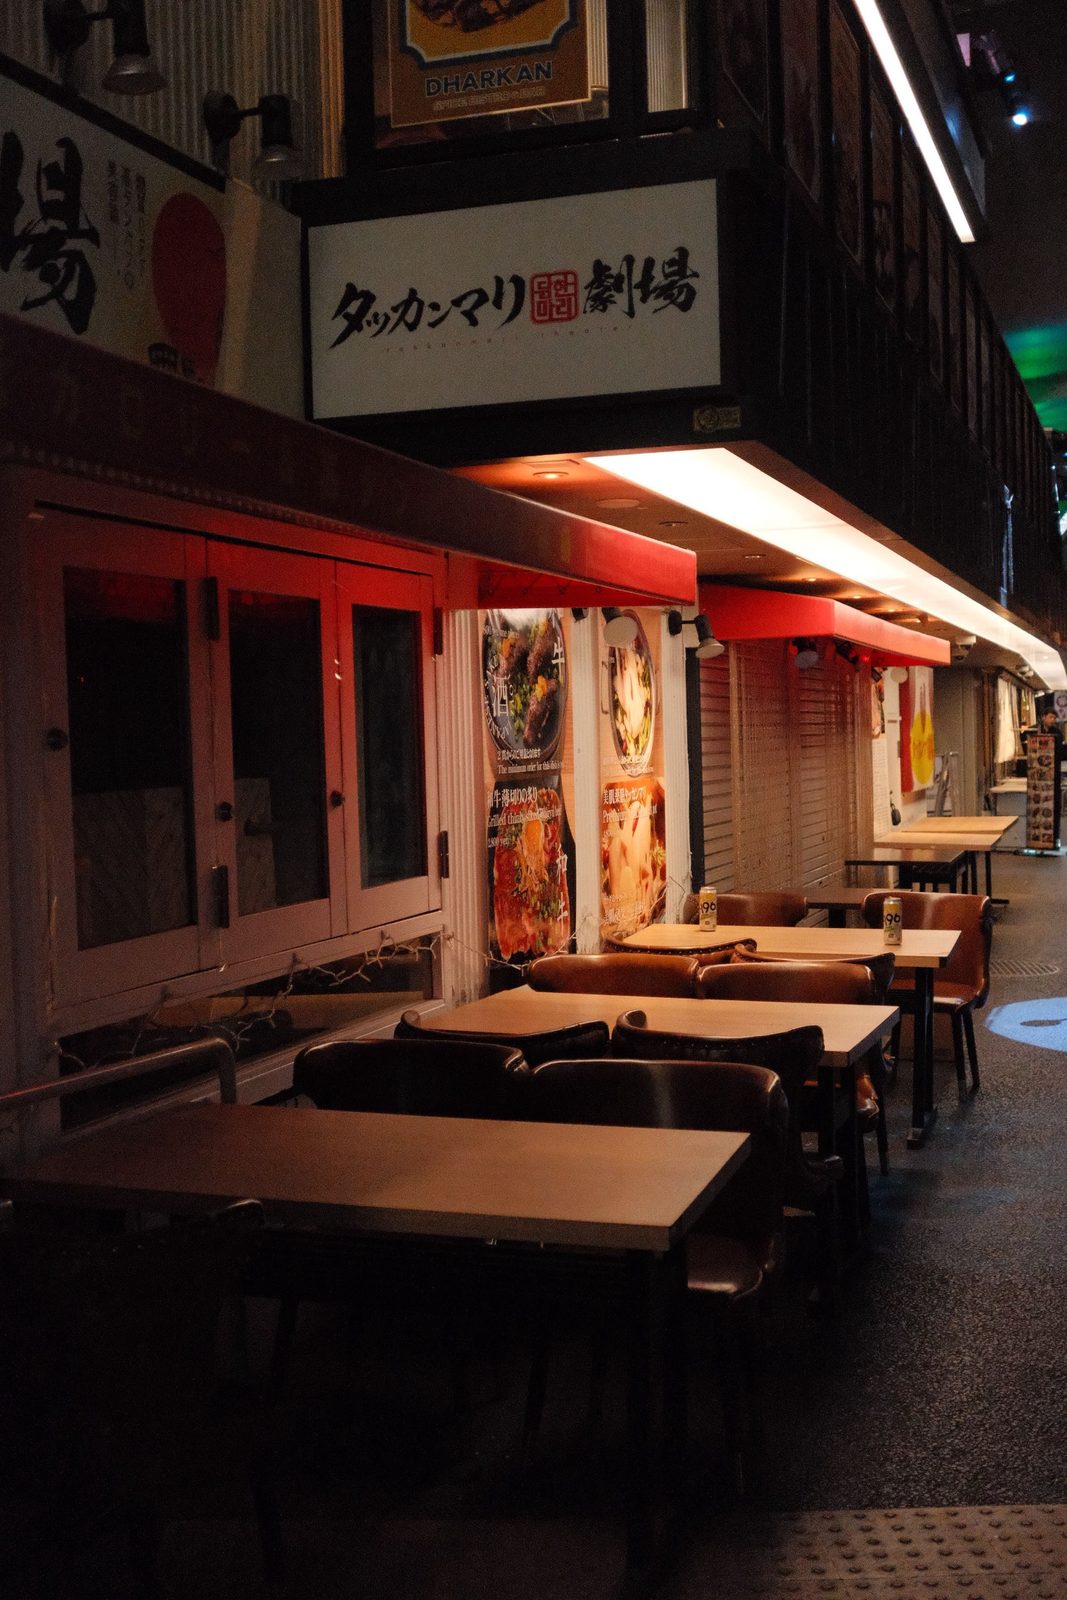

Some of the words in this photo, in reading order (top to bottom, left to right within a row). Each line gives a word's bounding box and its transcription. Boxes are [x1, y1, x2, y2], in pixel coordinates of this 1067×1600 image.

[425, 61, 552, 97] DHARKAN
[329, 274, 525, 349] タッカンマリ
[583, 246, 700, 318] 劇場
